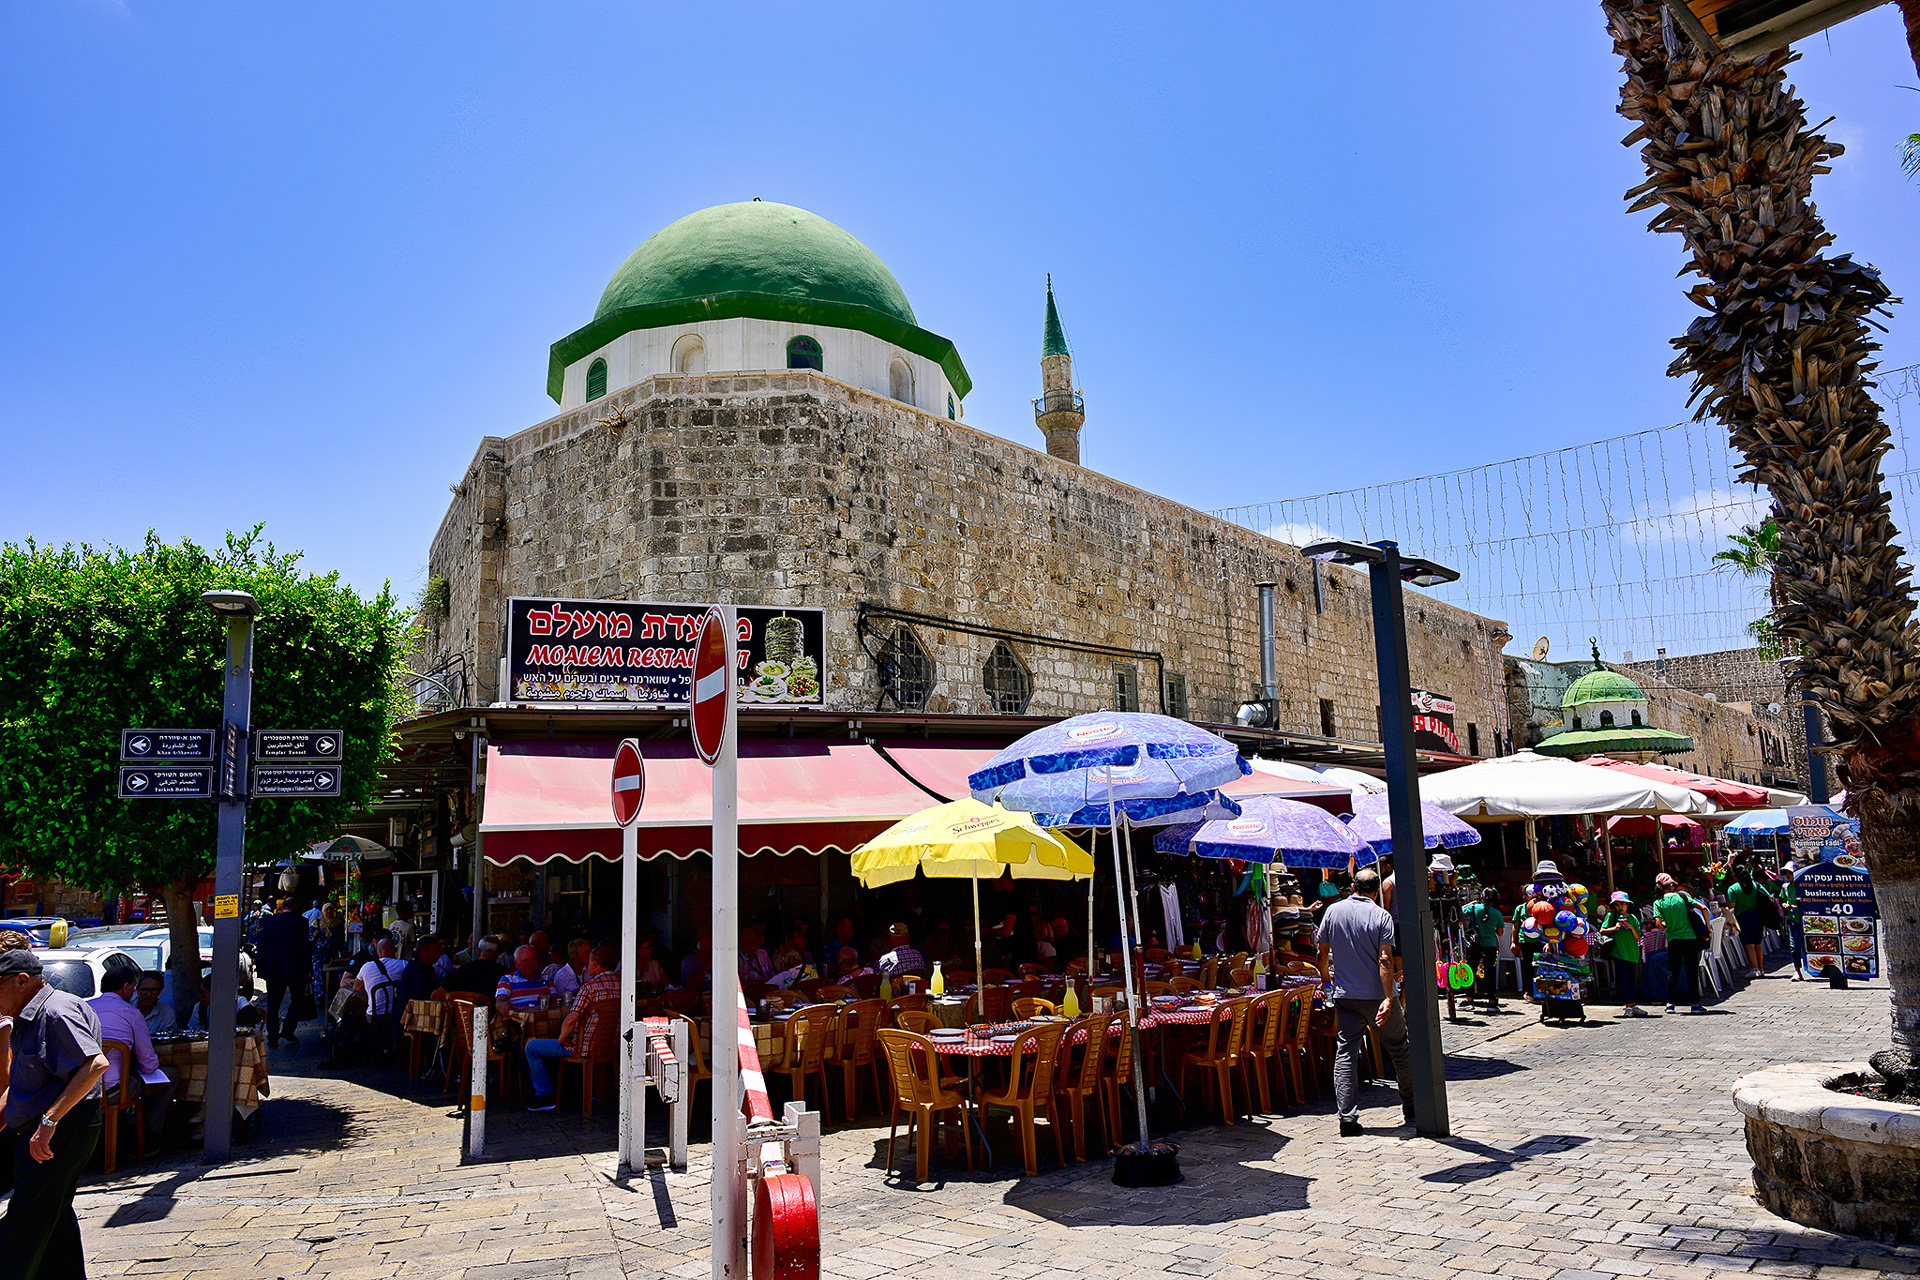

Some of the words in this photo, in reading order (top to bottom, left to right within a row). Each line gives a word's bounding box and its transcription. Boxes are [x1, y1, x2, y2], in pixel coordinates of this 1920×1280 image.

[527, 603, 633, 639] מועלם
[641, 612, 753, 643] מעדת
[525, 645, 625, 667] MOALEM
[523, 673, 546, 682] האש
[547, 672, 561, 683] על
[564, 672, 598, 683] ובשרים
[600, 674, 621, 684] דגים
[629, 675, 670, 684] שווארמה
[526, 686, 561, 699] مشوية
[563, 688, 594, 700] ولحوم
[1429, 716, 1460, 753] חומוס
[952, 818, 1000, 835] Schweppes
[1793, 816, 1833, 827] חומוס
[1797, 827, 1831, 838] פאדי
[1804, 875, 1833, 883] עסקית
[1804, 889, 1840, 897] business
[1831, 904, 1854, 915] 40
